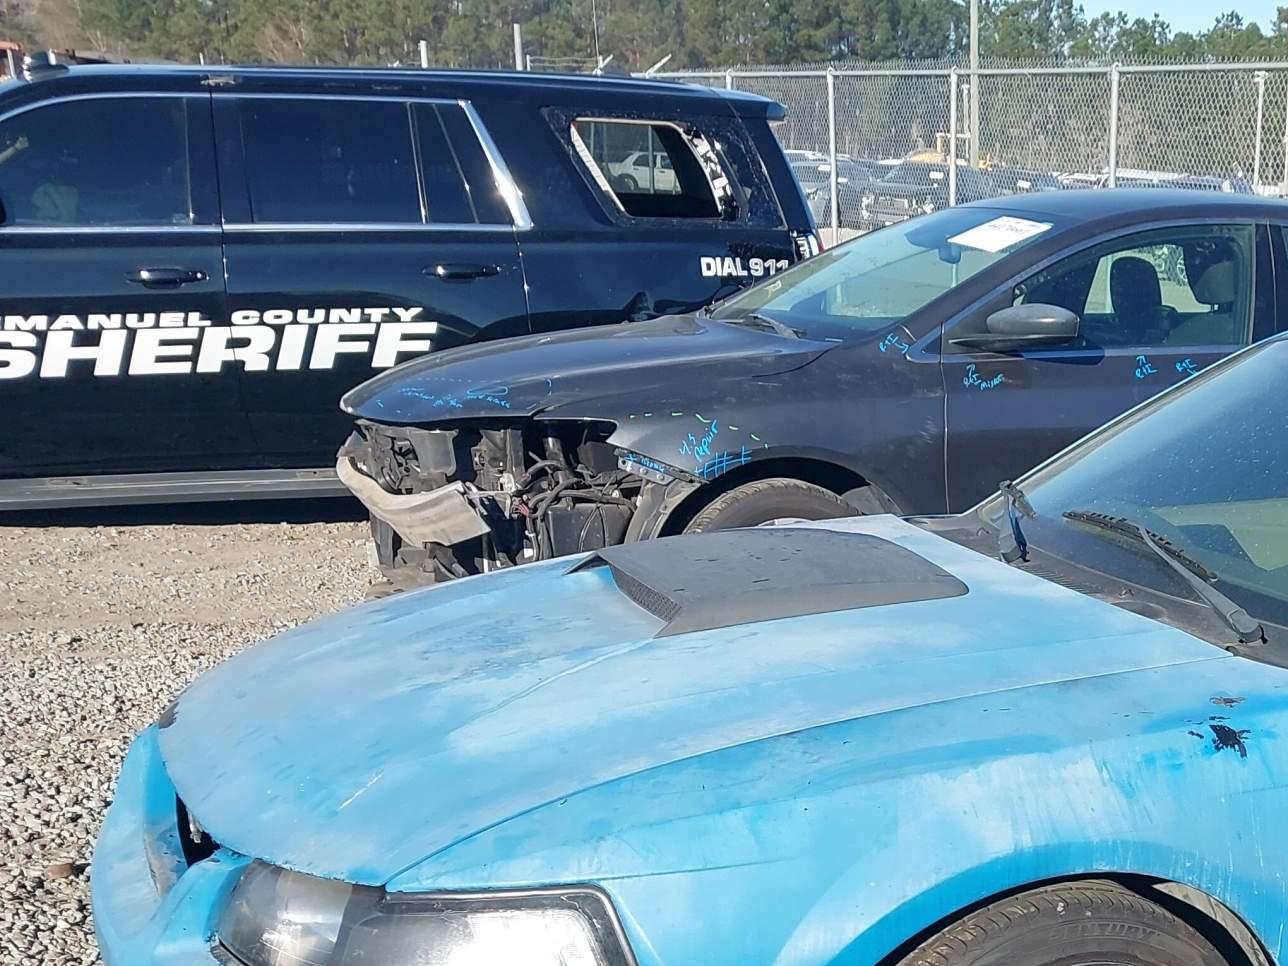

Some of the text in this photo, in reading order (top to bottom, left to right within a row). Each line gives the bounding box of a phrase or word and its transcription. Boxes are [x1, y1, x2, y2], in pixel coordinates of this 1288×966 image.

[700, 256, 789, 277] DIAL 911
[0, 307, 424, 331] MANUEL COUNTY
[0, 321, 438, 379] SHERIFF
